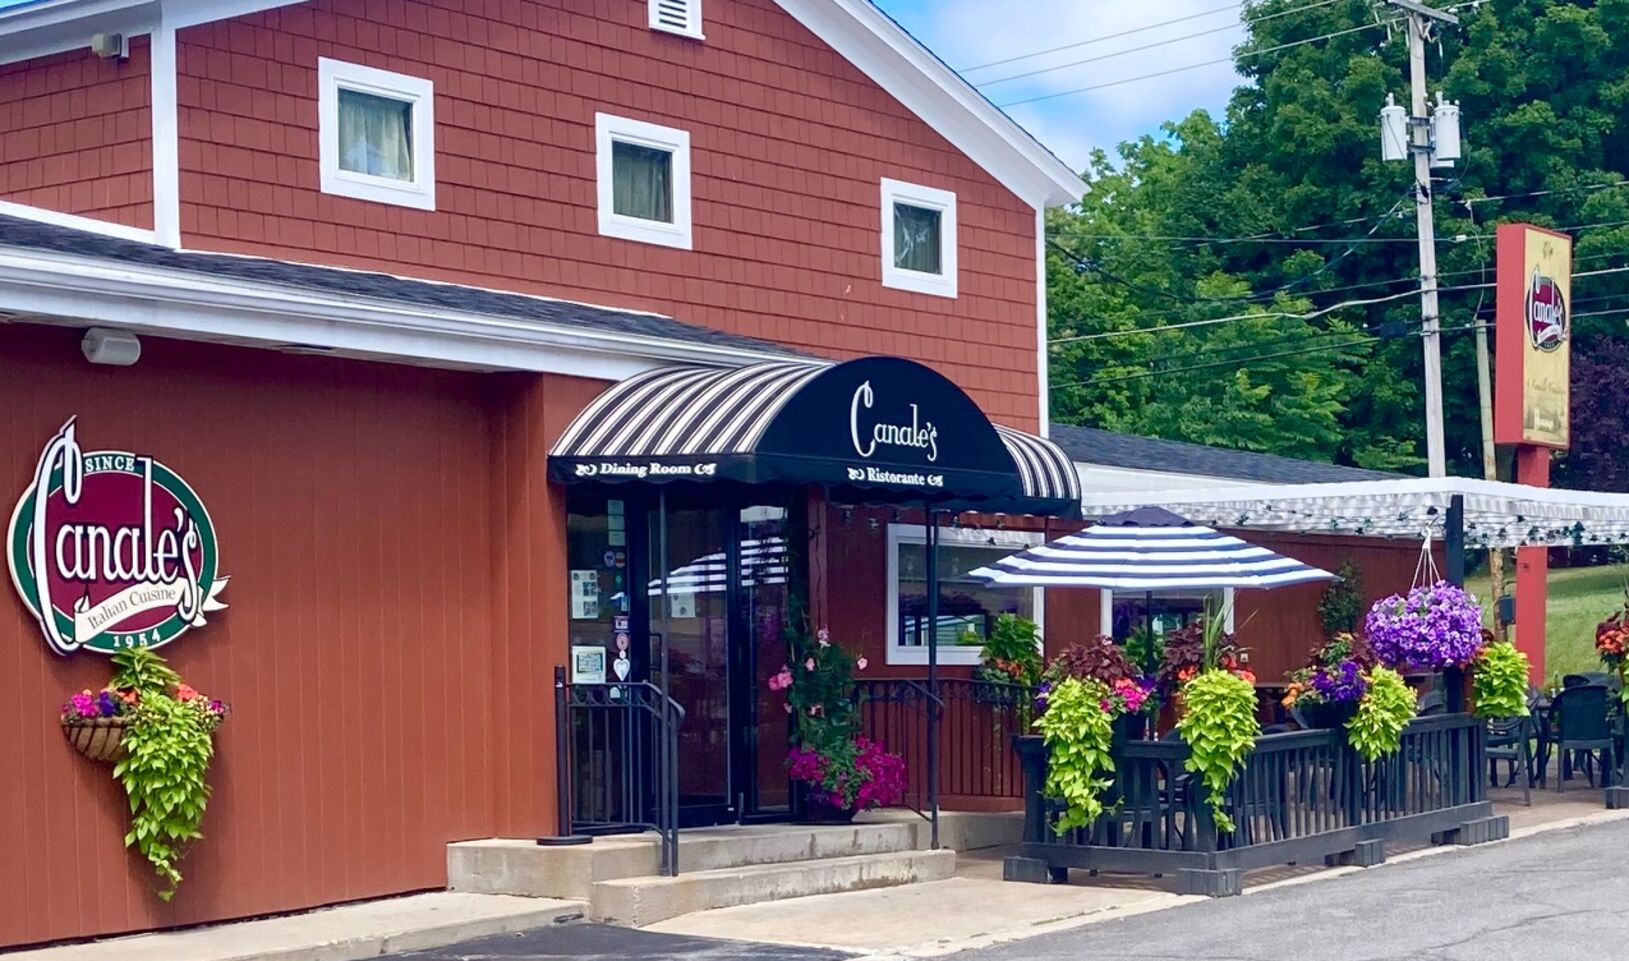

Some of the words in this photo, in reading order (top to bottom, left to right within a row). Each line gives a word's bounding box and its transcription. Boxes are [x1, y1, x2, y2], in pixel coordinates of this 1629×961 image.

[850, 380, 938, 461] Canale's
[85, 455, 135, 473] SINCE
[600, 463, 648, 478] Dining
[649, 463, 692, 475] Room
[866, 467, 926, 486] Ristorante
[34, 418, 198, 651] Canale's
[88, 600, 128, 630] Italian
[129, 586, 176, 607] Cuisine
[113, 628, 161, 648] 1954
